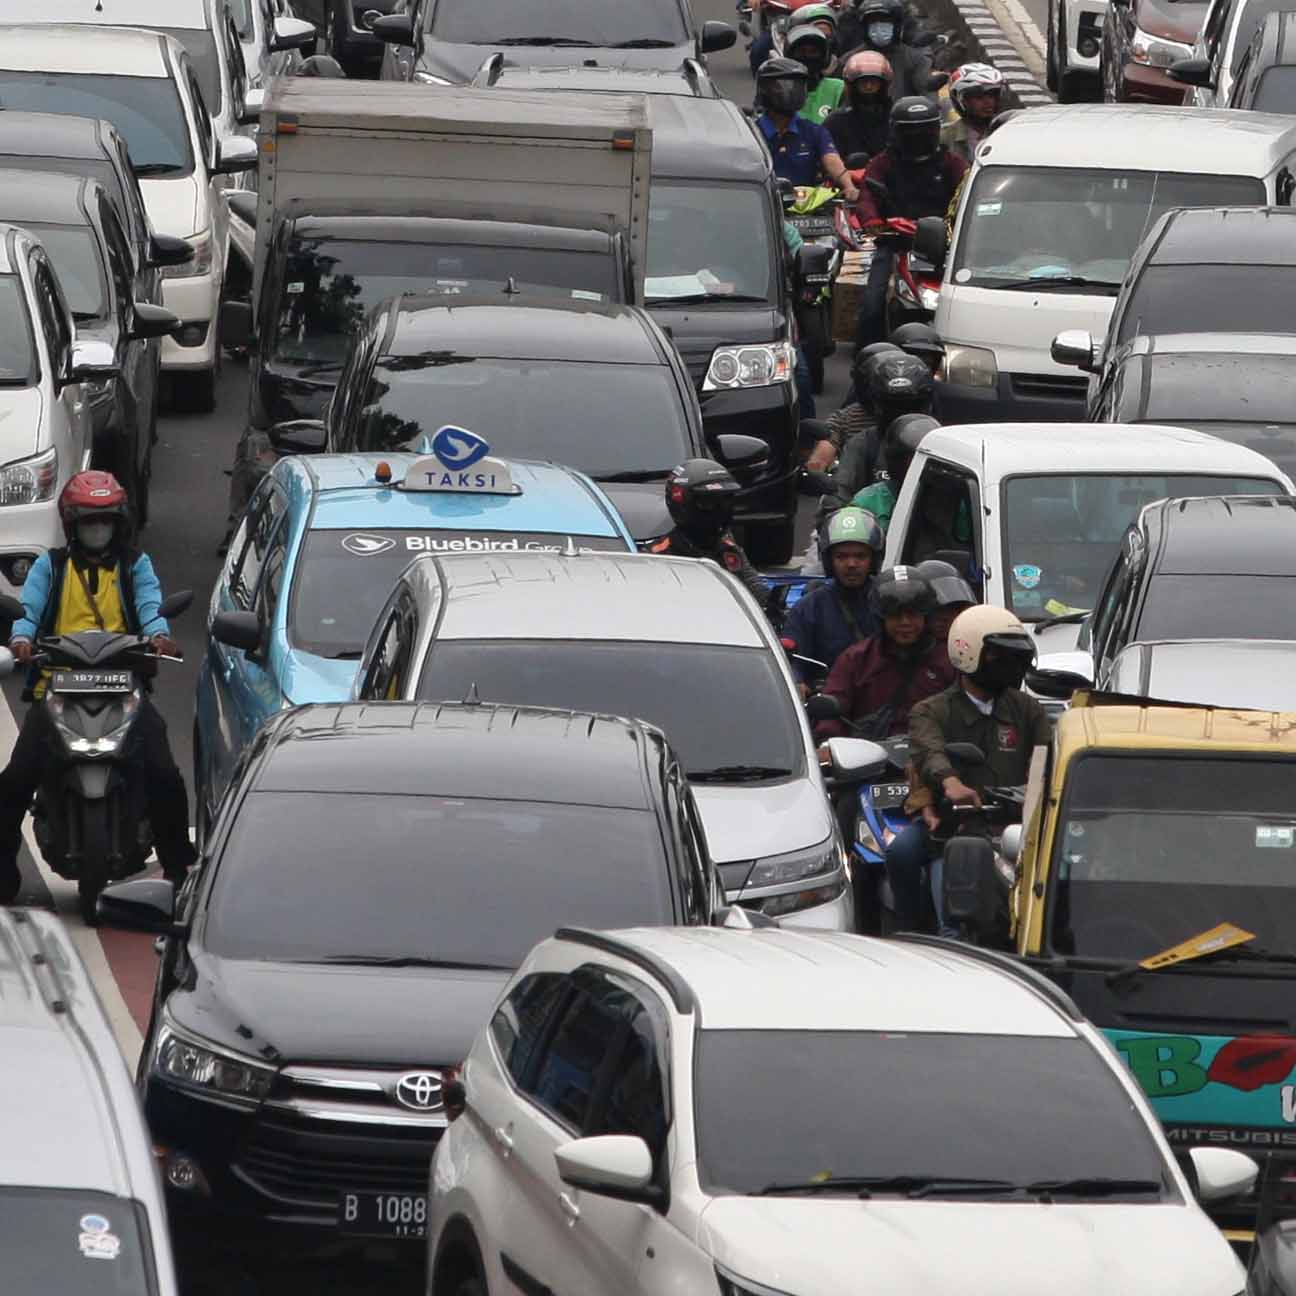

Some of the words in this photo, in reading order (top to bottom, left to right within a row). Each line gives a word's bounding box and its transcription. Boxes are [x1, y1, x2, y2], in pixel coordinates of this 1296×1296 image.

[425, 472, 496, 488] TAKSI
[406, 536, 519, 552] Bluebird
[888, 786, 910, 796] 539
[345, 1194, 358, 1221] B
[376, 1195, 426, 1223] 1088
